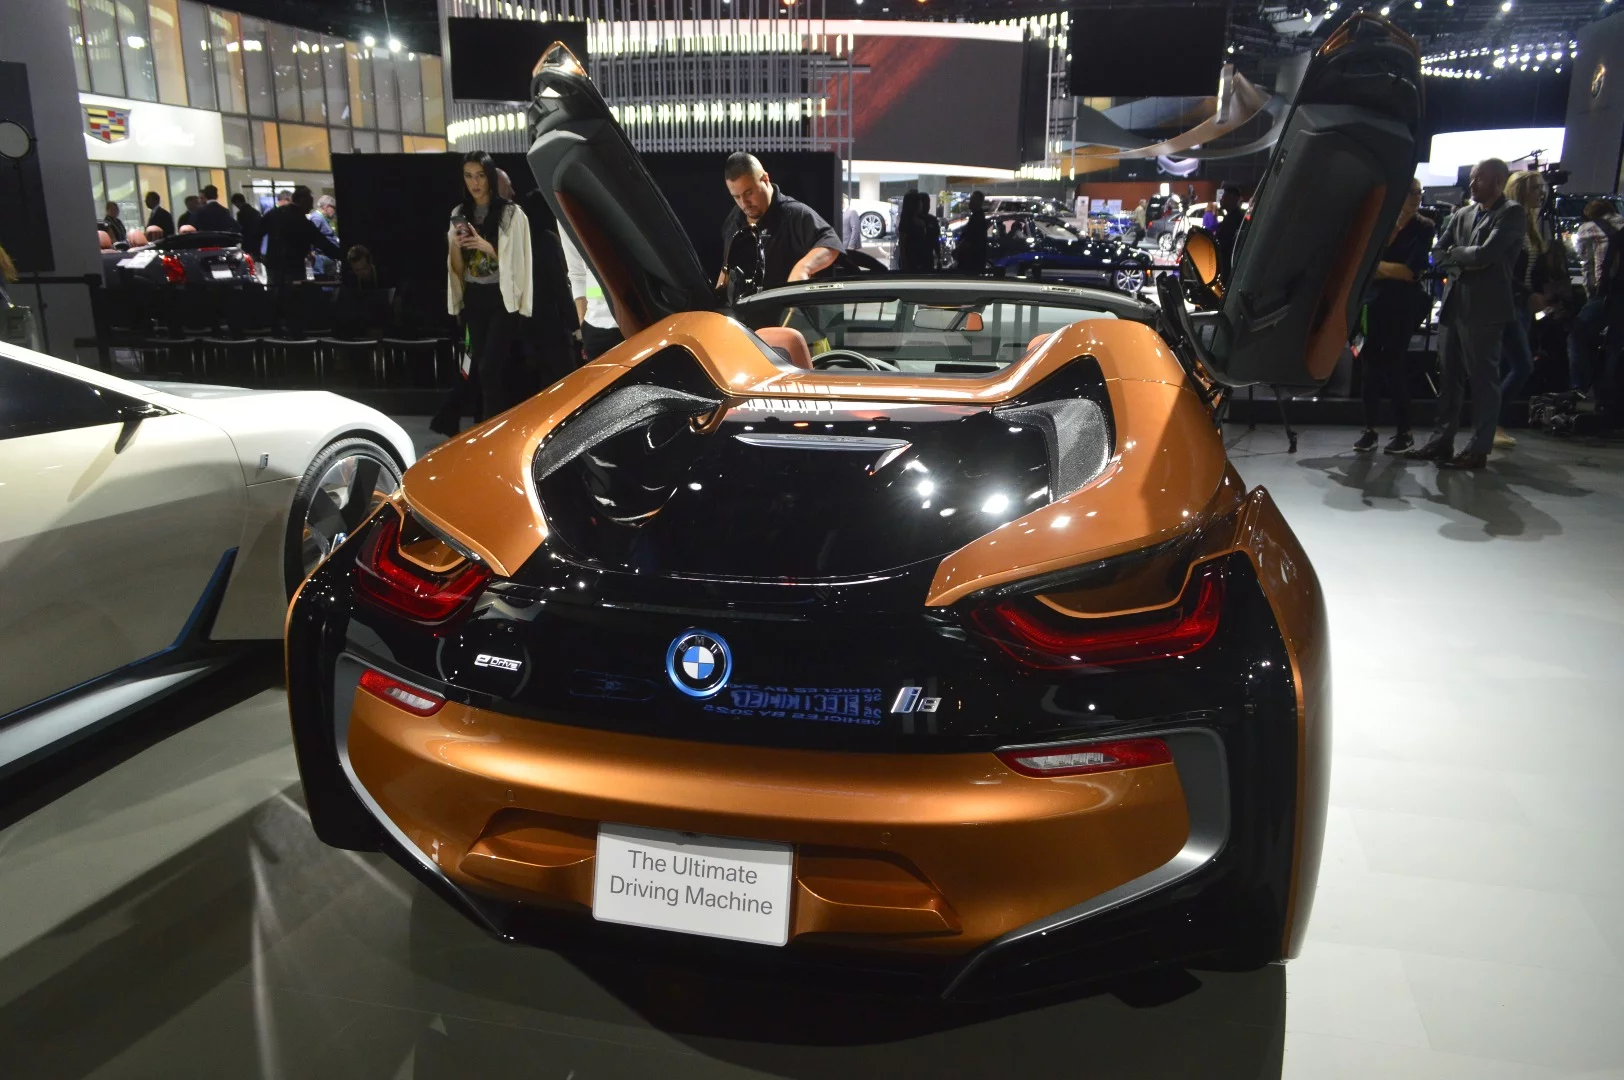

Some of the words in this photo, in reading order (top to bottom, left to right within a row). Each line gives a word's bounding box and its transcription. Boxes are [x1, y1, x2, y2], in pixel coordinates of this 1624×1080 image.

[679, 635, 722, 656] BMW
[628, 850, 667, 873] The
[673, 855, 758, 885] Ultimate
[610, 875, 679, 907] Driving
[685, 885, 773, 915] Machine
